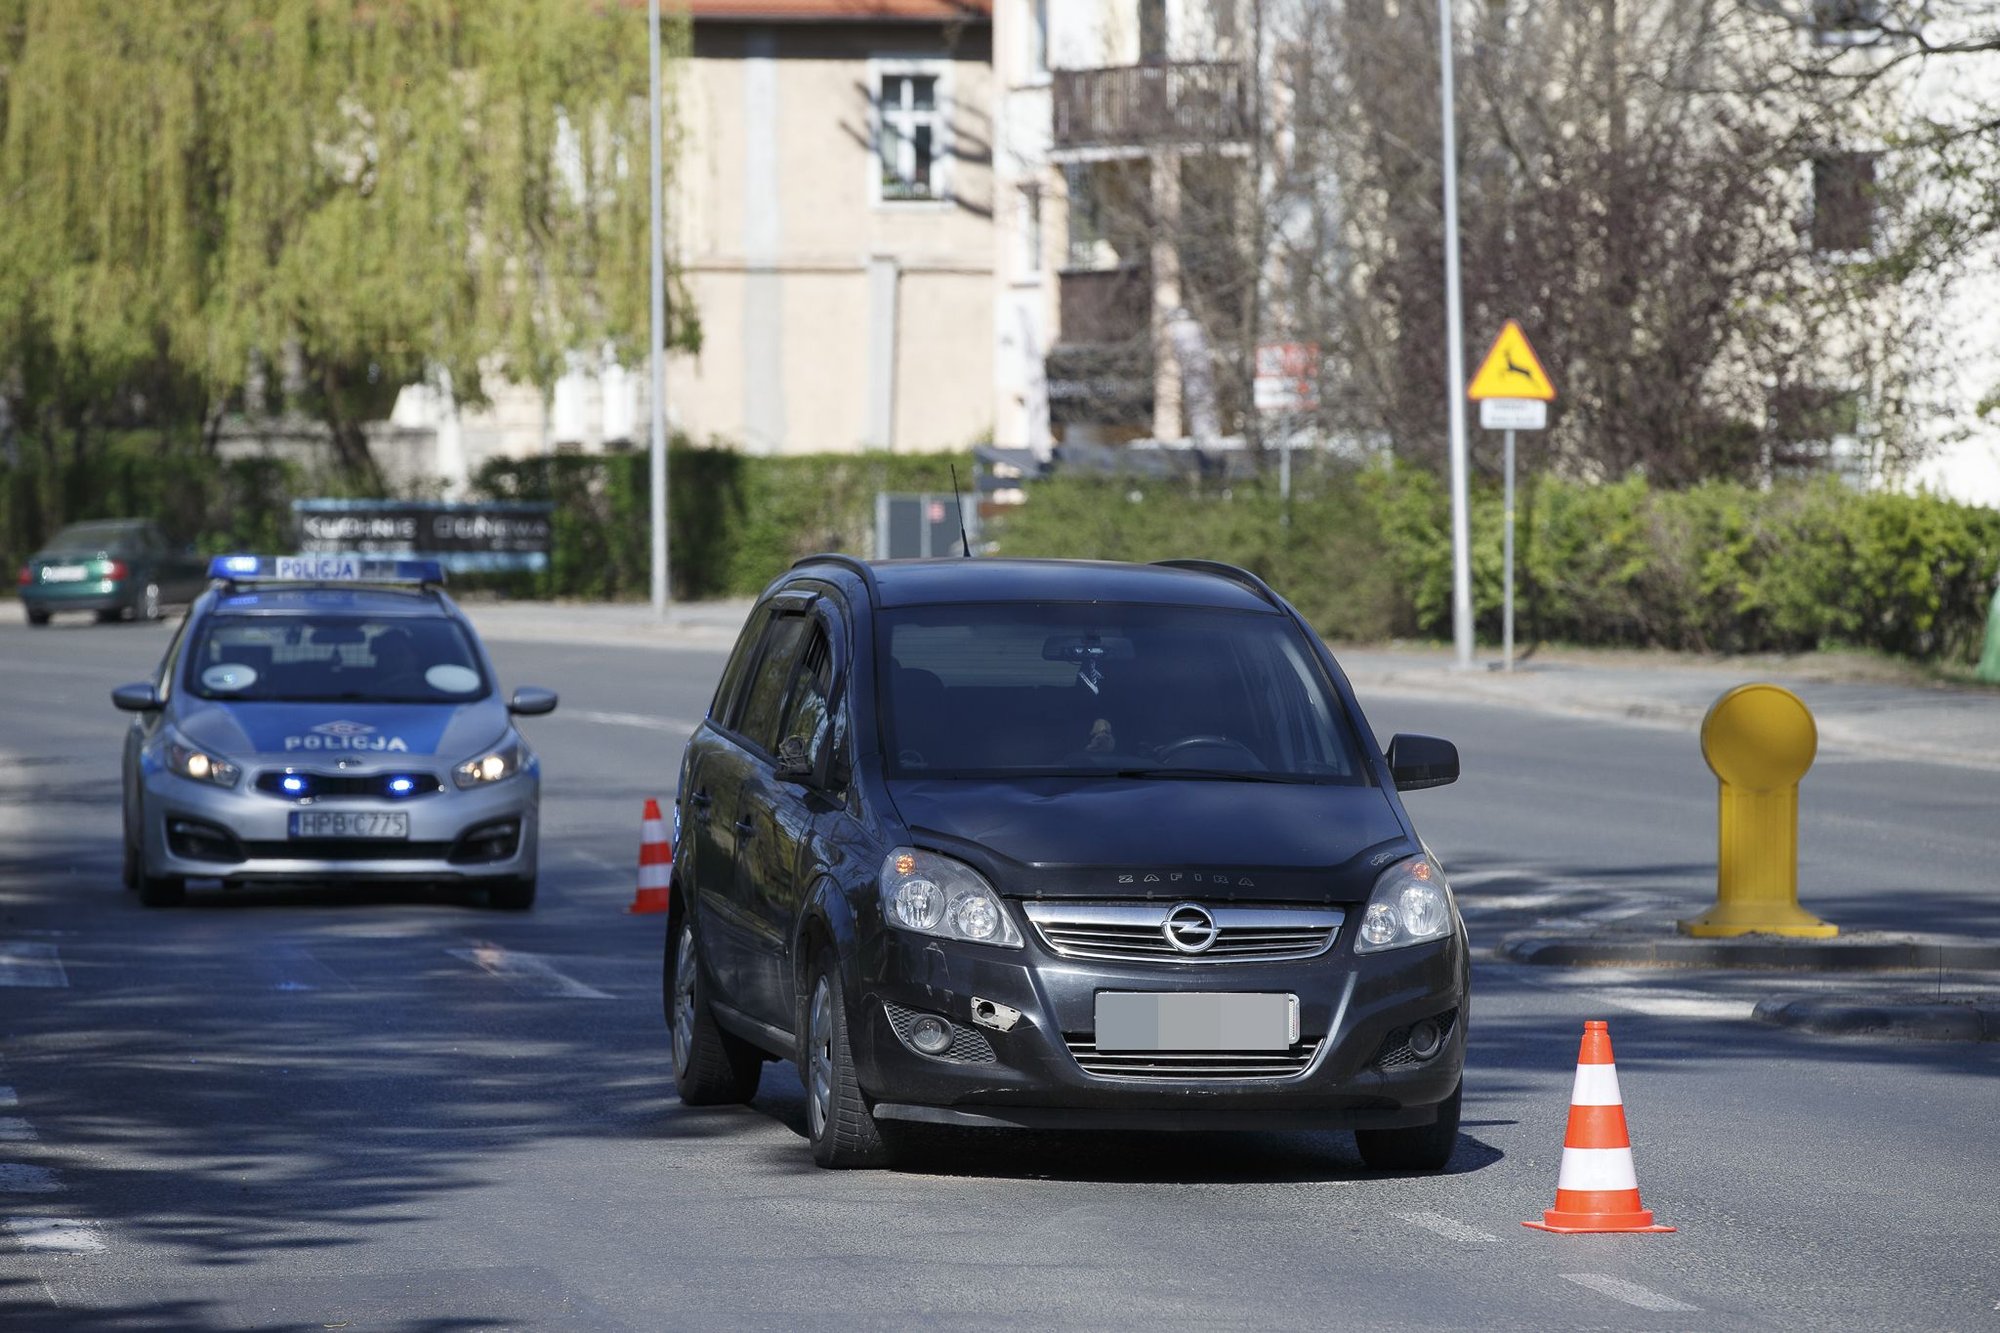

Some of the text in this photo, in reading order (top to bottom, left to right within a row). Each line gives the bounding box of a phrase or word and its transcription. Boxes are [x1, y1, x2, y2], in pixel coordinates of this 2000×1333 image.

[281, 560, 353, 578] POLICJA
[285, 735, 408, 752] POLICJA
[1118, 873, 1255, 887] ZAFIRA
